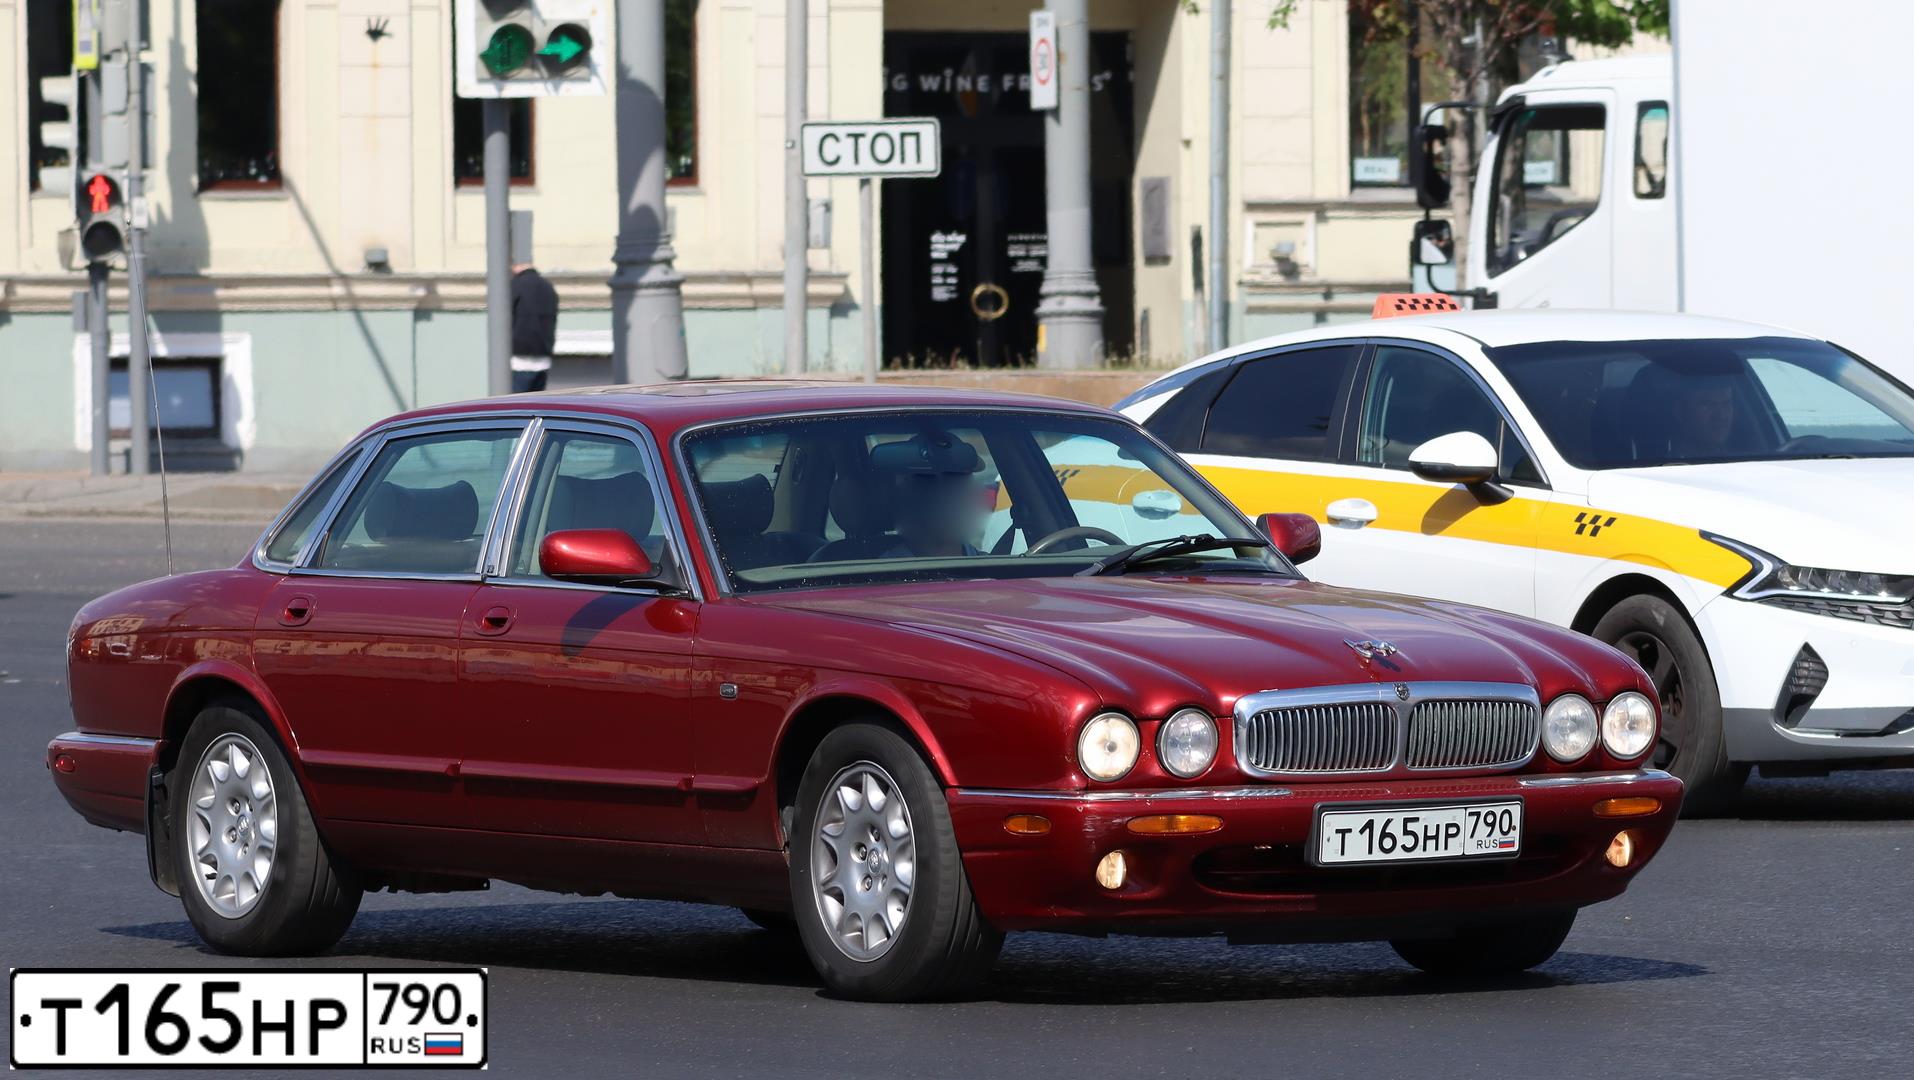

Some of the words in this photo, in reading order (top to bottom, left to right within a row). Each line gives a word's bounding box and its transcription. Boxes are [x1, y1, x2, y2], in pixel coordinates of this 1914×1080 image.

[818, 131, 922, 166] СТОП
[1467, 808, 1514, 839] 790
[1476, 838, 1498, 849] RUS
